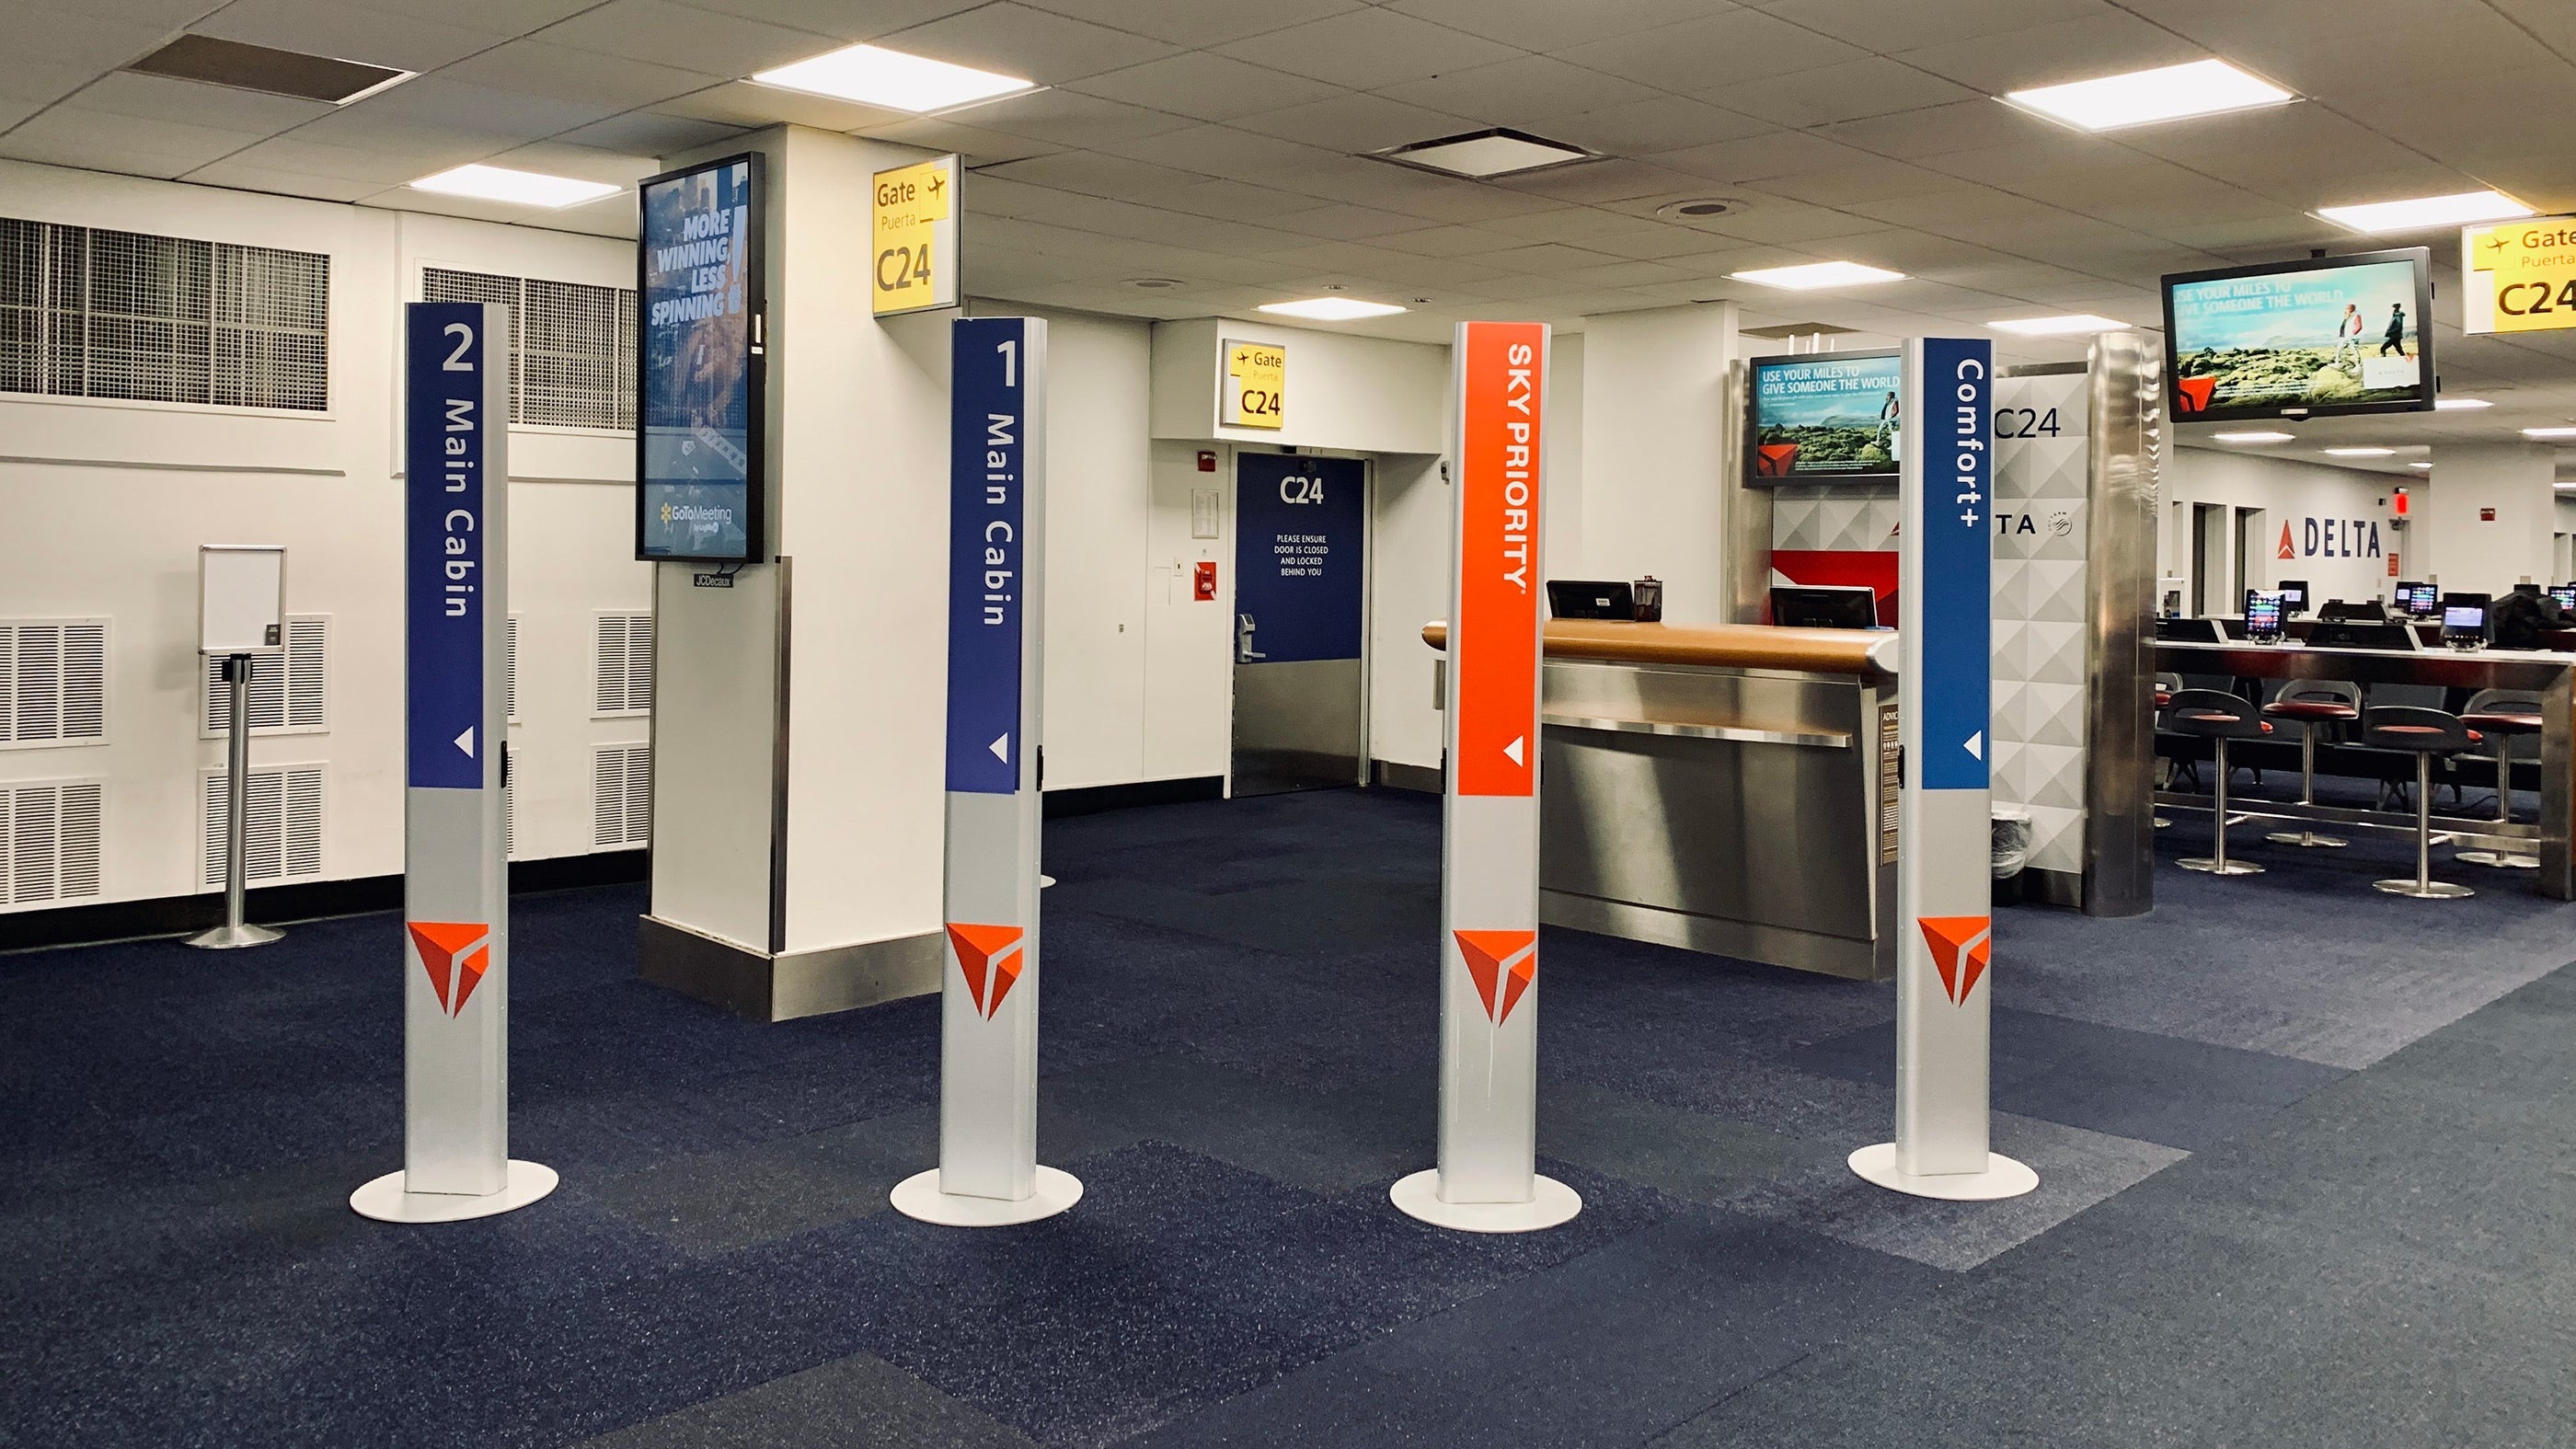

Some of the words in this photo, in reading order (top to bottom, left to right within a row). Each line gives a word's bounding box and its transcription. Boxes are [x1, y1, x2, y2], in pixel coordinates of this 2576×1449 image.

[878, 181, 915, 207] Gate
[684, 209, 730, 241] MORE
[881, 213, 915, 231] Puerta
[2522, 229, 2576, 248] Gate
[657, 236, 731, 273] WINNING,
[877, 243, 931, 292] C24
[2522, 254, 2576, 268] Puerta
[691, 264, 727, 293] LESS
[2195, 285, 2230, 301] YOUR
[2234, 282, 2270, 297] MILES
[2274, 281, 2292, 293] TO
[650, 292, 724, 328] SPINNING
[2202, 297, 2263, 314] SOMEONE
[2266, 294, 2292, 308] THE
[2294, 290, 2343, 305] WORLD
[2498, 279, 2576, 316] C24
[442, 323, 474, 372] 2
[1254, 351, 1282, 368] Gate
[996, 339, 1016, 387] 1
[1253, 370, 1279, 382] Puerta
[1763, 370, 1781, 383] USE
[1783, 368, 1811, 381] YOUR
[1813, 367, 1844, 379] MILES
[1846, 365, 1859, 377] TO
[1506, 343, 1533, 416] SKY
[1763, 383, 1786, 395] GIVE
[1788, 380, 1837, 394] SOMEONE
[1839, 378, 1859, 390] THE
[1861, 375, 1900, 389] WORLD
[1242, 389, 1281, 416] C24
[1995, 408, 2061, 439] C24
[445, 398, 475, 493] Main
[1957, 358, 1984, 528] Comfort+
[986, 414, 1015, 505] Main
[1280, 476, 1324, 504] C24
[673, 505, 731, 524] GoToMeeting
[1503, 422, 1530, 592] PRIORITY
[1274, 546, 1294, 554] DOOR
[1295, 546, 1303, 554] IS
[1304, 546, 1329, 554] CLOSED
[1277, 535, 1300, 543] PLEASE
[1302, 535, 1327, 544] ENSURE
[2305, 517, 2381, 558] DELTA
[445, 509, 475, 616] Cabin
[983, 520, 1013, 626] Cabin
[1281, 557, 1295, 565] AND
[1296, 557, 1323, 565] LOCKED
[1281, 568, 1305, 576] BEHIND
[1307, 568, 1322, 576] YOU
[696, 575, 730, 587] JCDecaux
